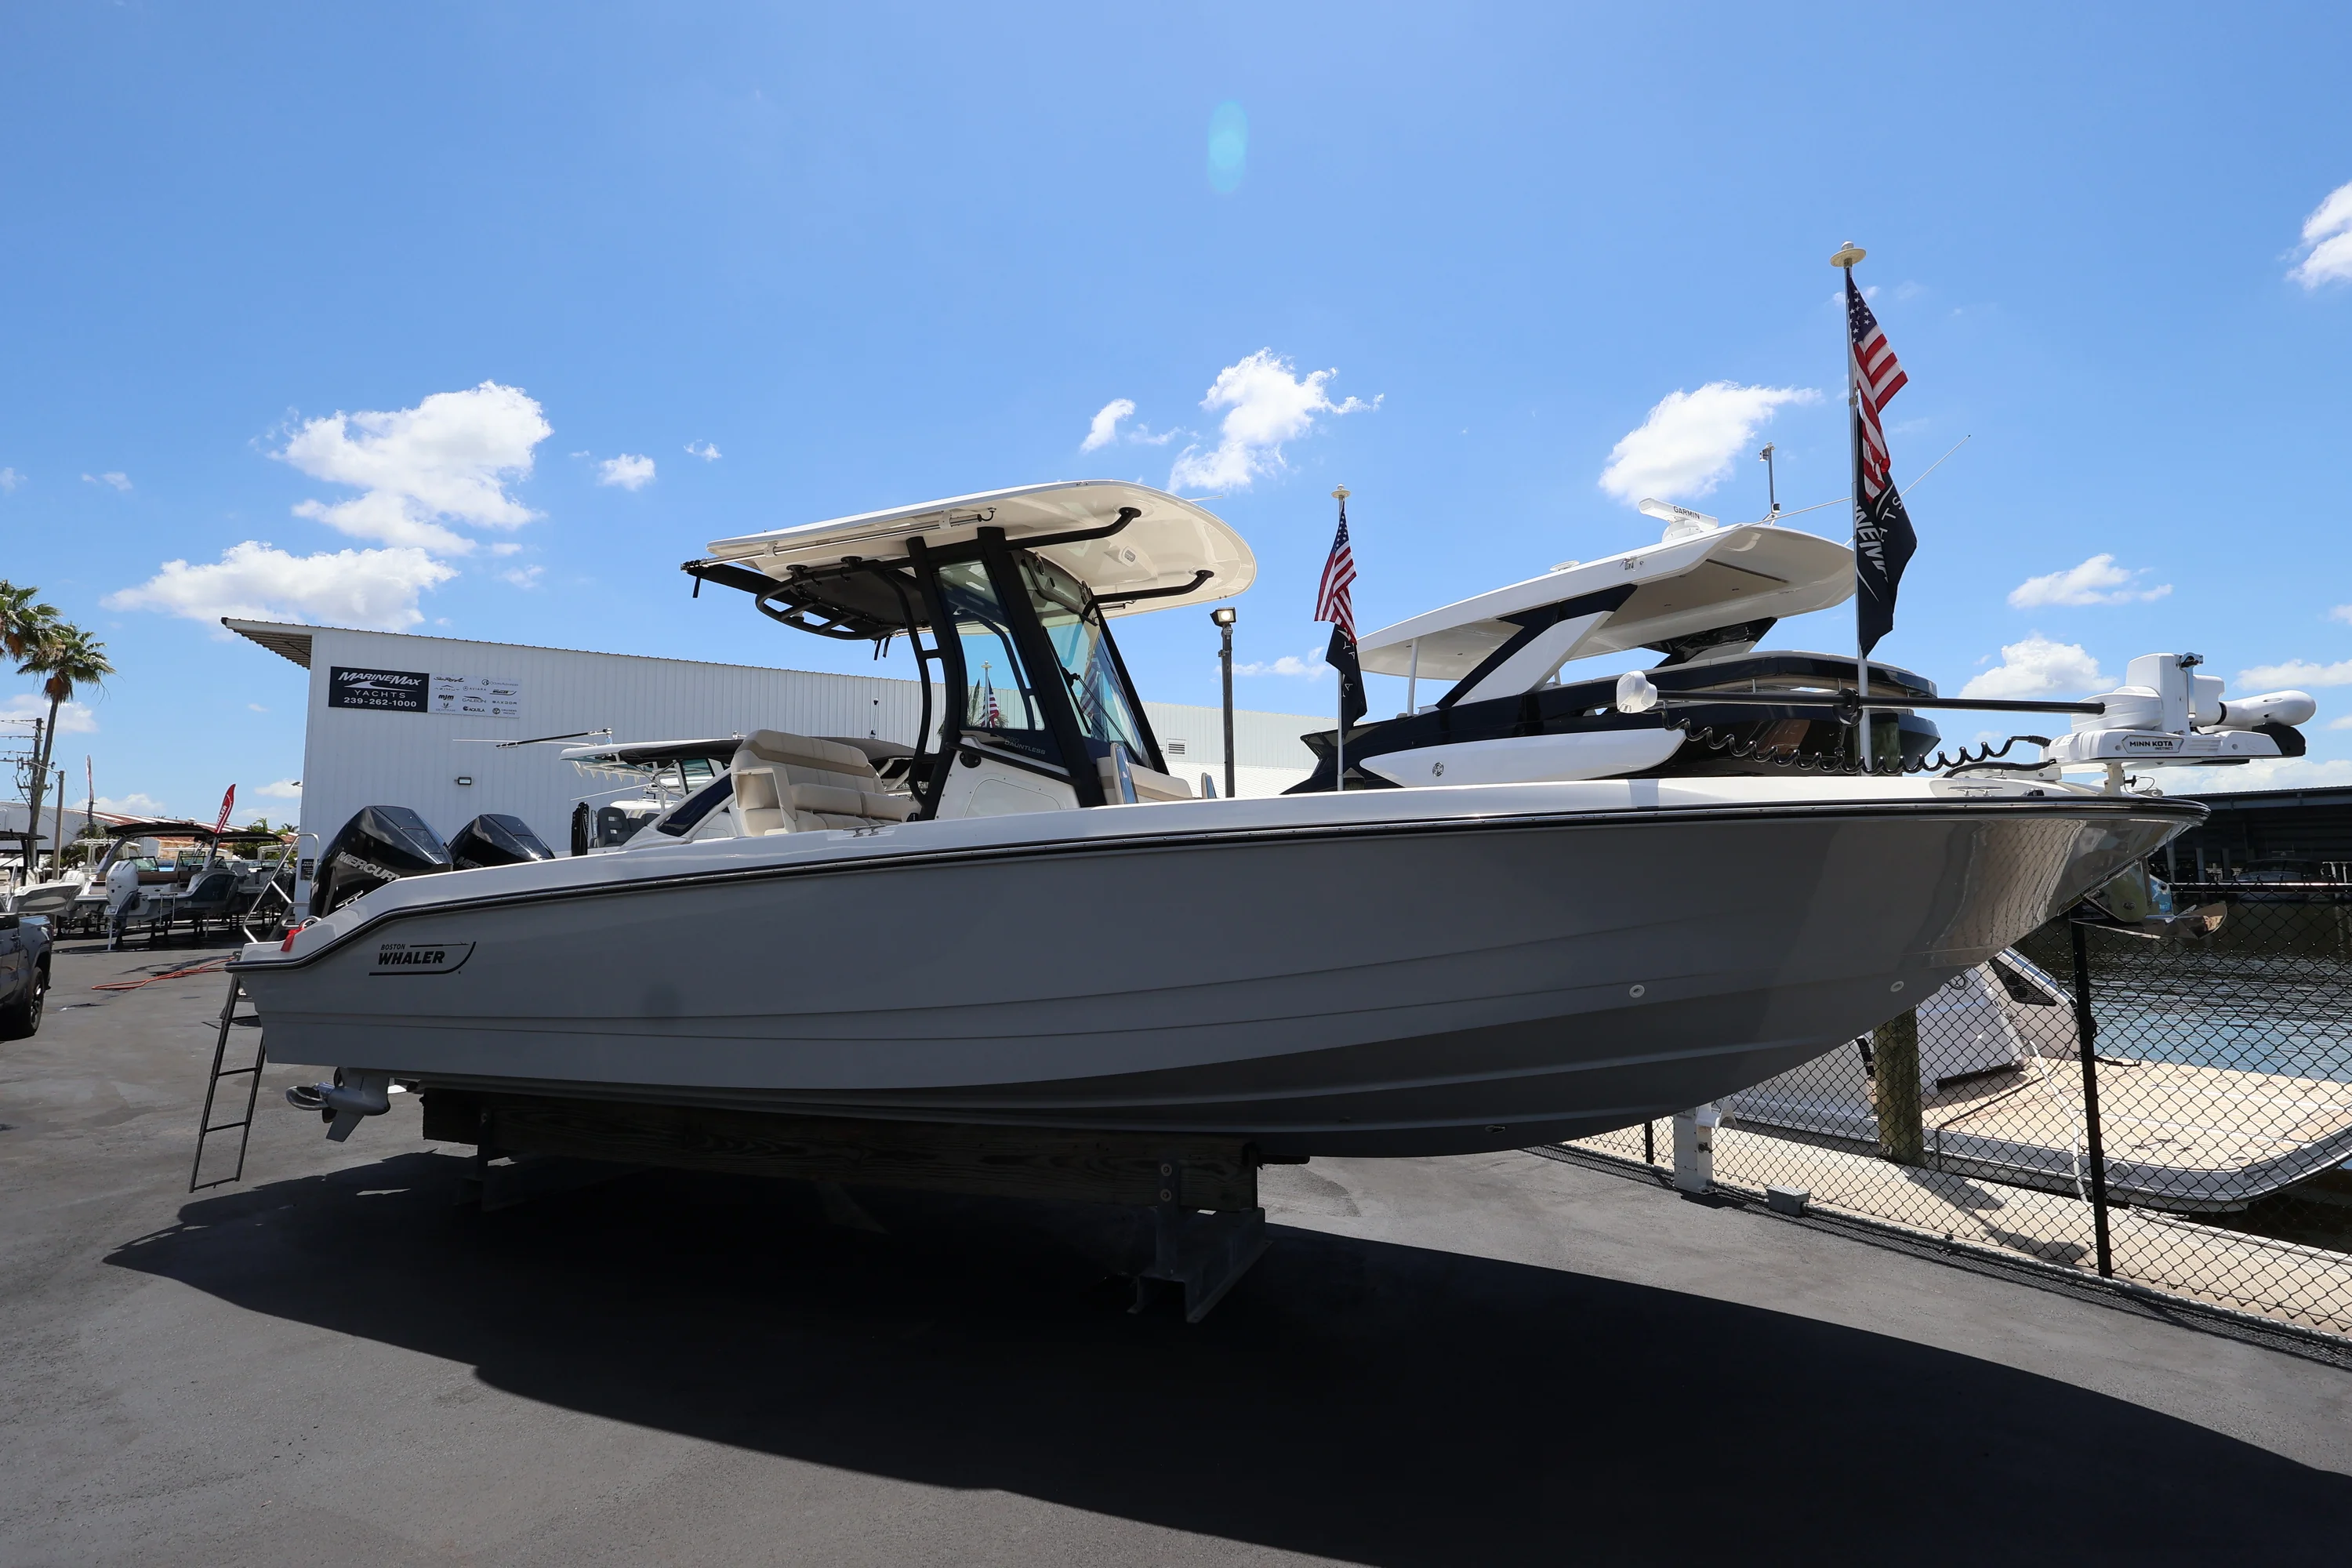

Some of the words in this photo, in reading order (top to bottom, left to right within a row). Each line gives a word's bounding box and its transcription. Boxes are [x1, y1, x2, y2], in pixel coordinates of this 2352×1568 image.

[1673, 506, 1700, 519] GARMIN
[343, 697, 417, 707] 239-262-1000
[1004, 740, 1046, 755] DAUNTLESS
[378, 951, 445, 965] WHALER
